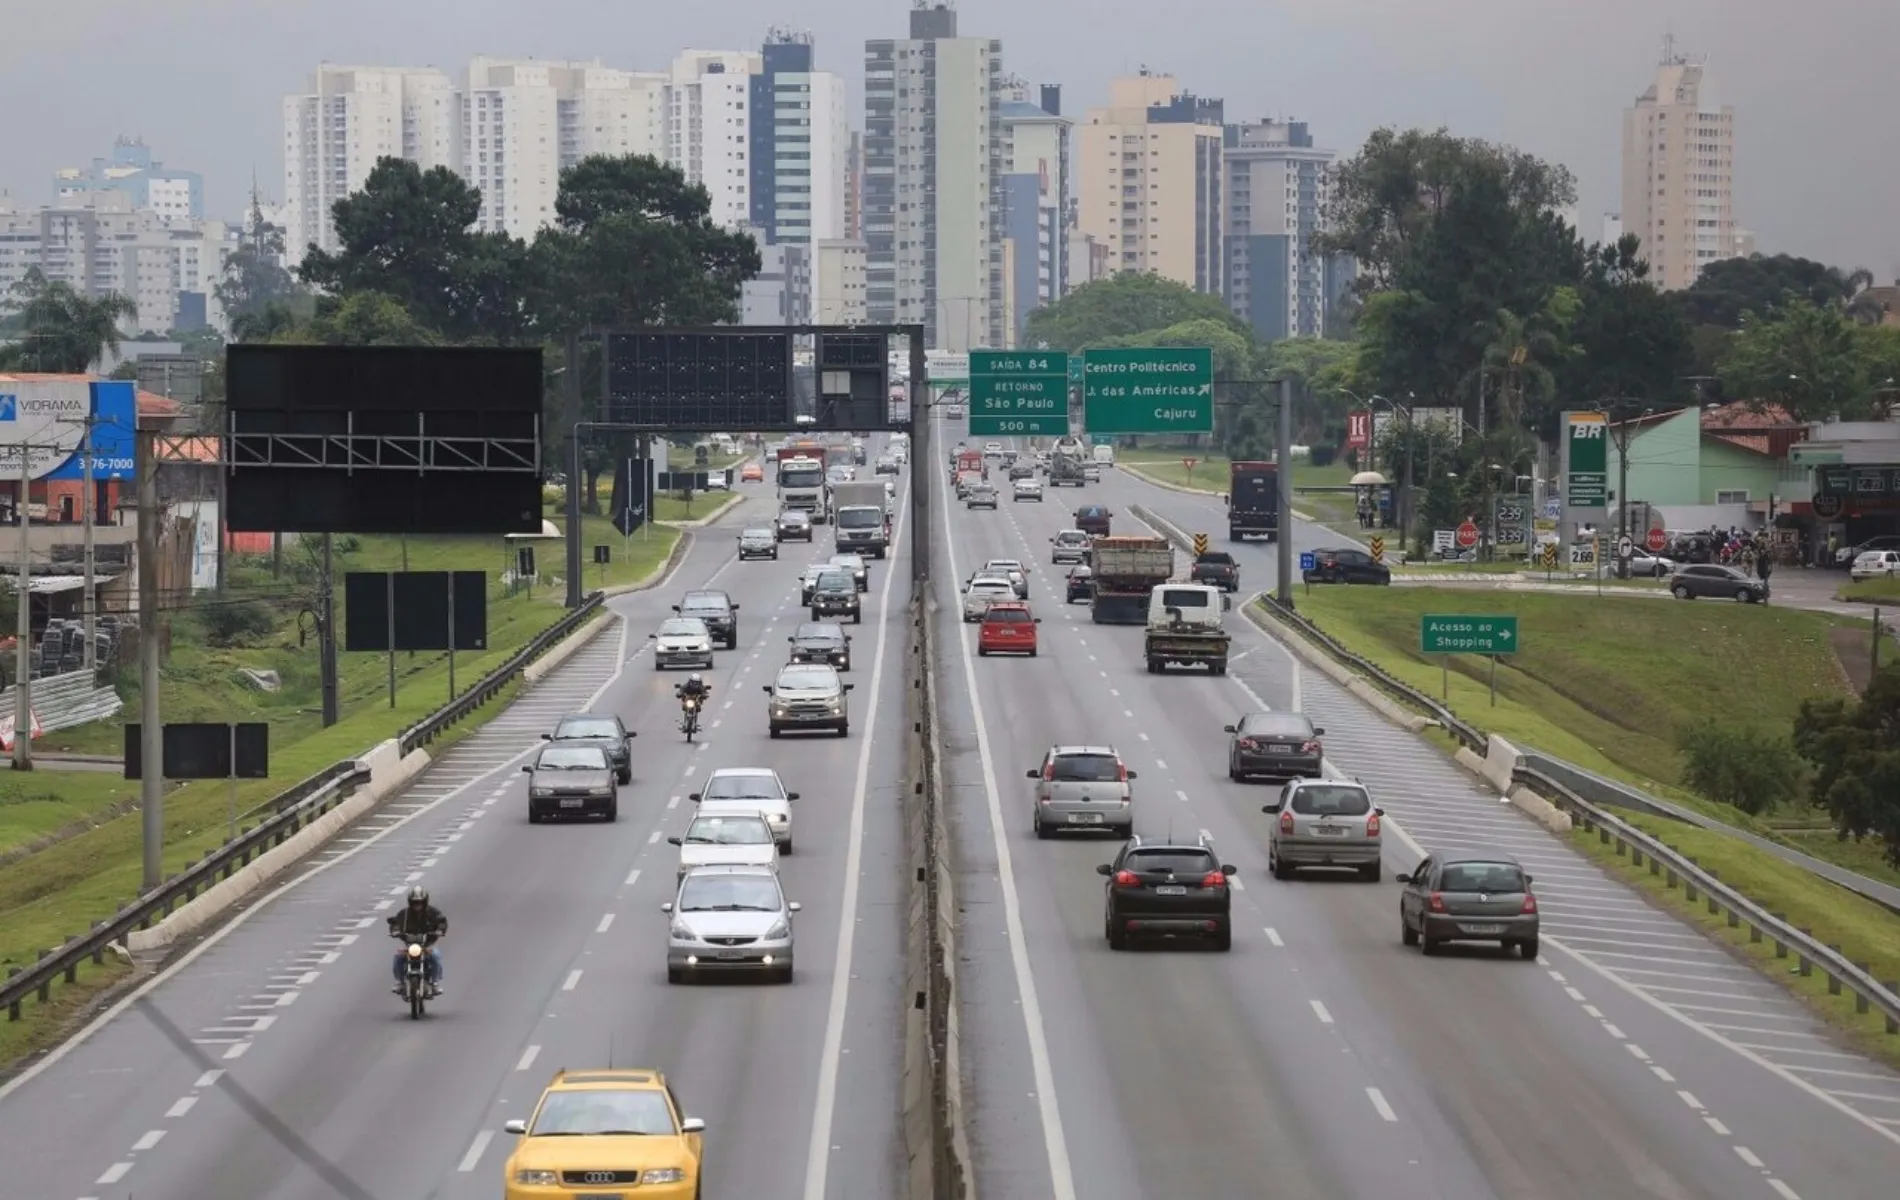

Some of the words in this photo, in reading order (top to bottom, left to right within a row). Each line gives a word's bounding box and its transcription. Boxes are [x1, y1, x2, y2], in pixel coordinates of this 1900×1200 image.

[990, 358, 1022, 370] SAÍDA
[1028, 359, 1048, 369] 84
[1085, 362, 1127, 373] Centro
[1129, 360, 1196, 373] Politécnico
[994, 382, 1043, 392] RETORNO
[1086, 386, 1097, 397] J.
[1101, 386, 1126, 396] das
[1132, 383, 1196, 396] Américas
[20, 400, 82, 411] VIDRAMA
[985, 397, 1010, 408] São
[1017, 398, 1054, 408] Paulo
[1154, 408, 1197, 420] Cajuru
[999, 421, 1024, 431] 500
[1030, 423, 1040, 431] m
[1574, 423, 1602, 439] BR
[79, 458, 134, 469] 376-7000
[1459, 529, 1477, 539] PARE
[1648, 534, 1667, 543] PARE
[1430, 622, 1472, 631] Acesso
[1436, 637, 1493, 648] Shopping
